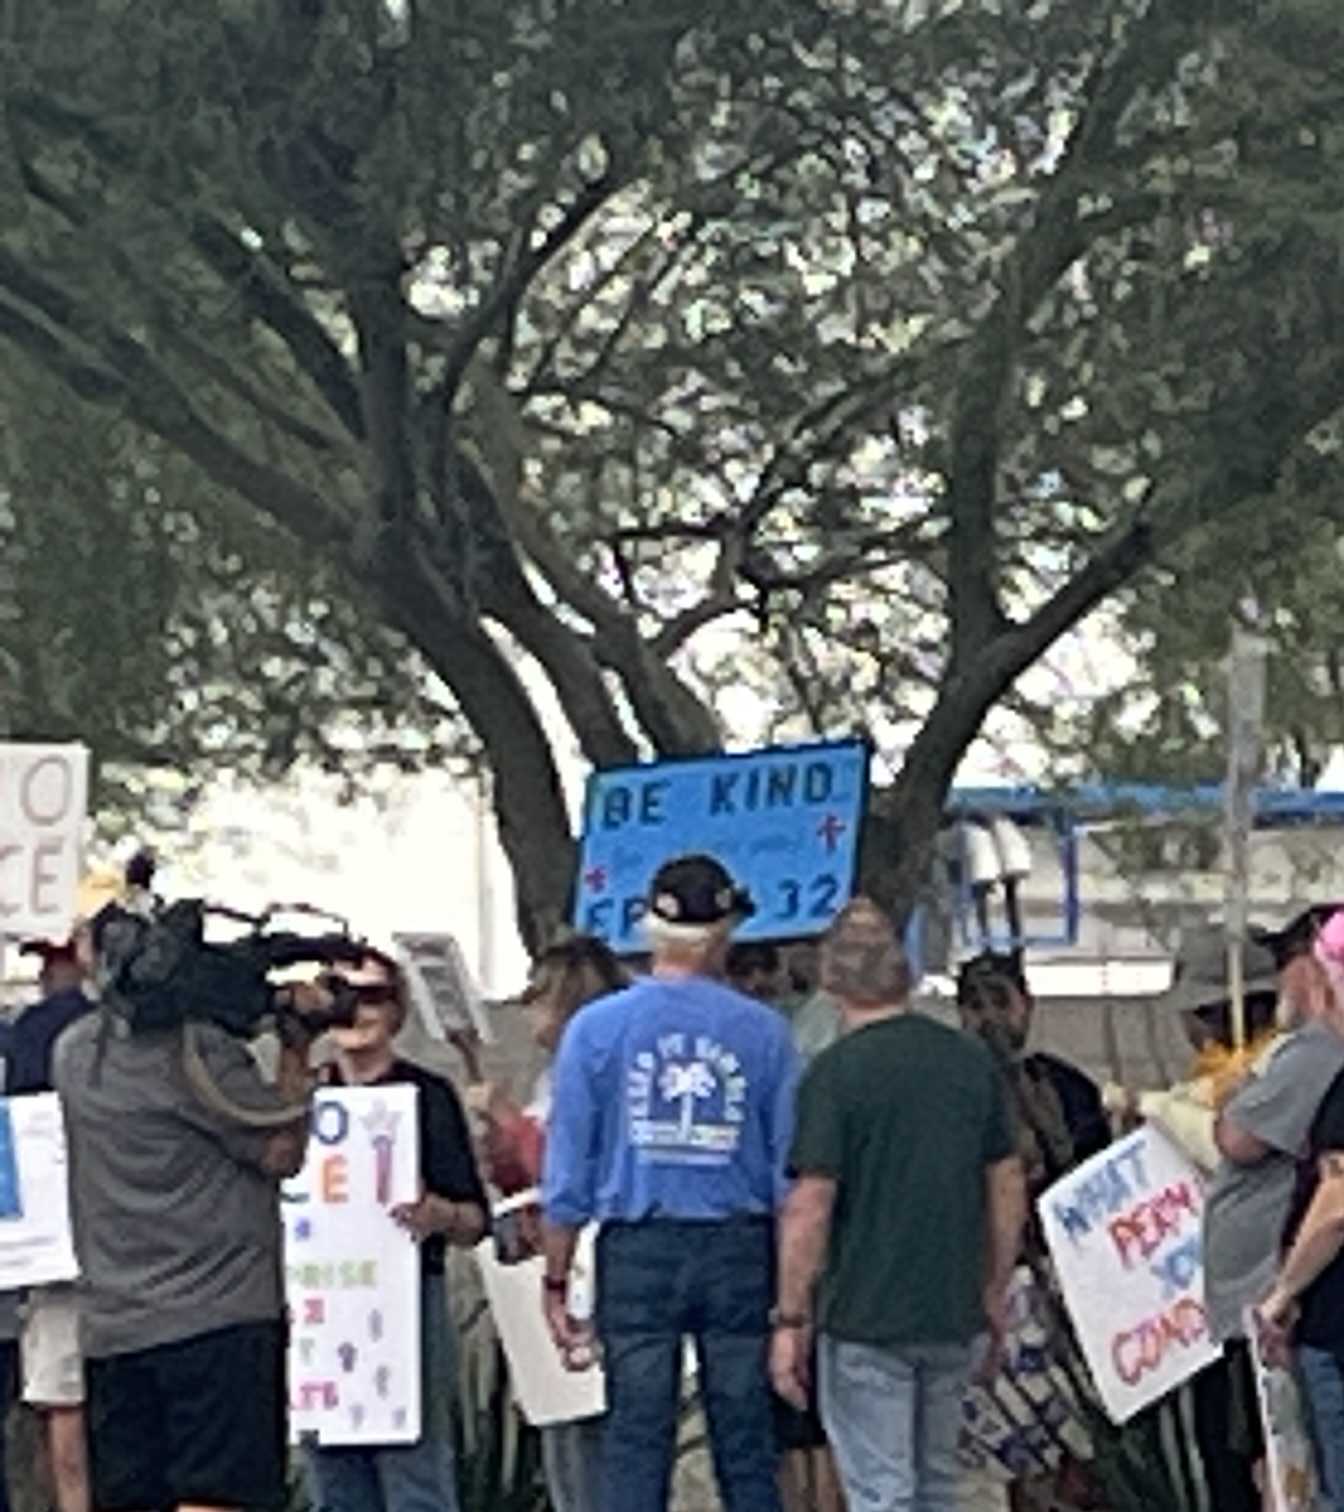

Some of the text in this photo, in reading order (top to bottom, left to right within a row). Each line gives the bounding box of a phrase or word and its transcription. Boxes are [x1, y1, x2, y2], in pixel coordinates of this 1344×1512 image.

[18, 753, 74, 827] O
[601, 762, 834, 831] BE KIND
[0, 836, 66, 915] CE
[586, 873, 841, 942] EP 32
[312, 1101, 349, 1146] O
[1107, 1180, 1200, 1271] PERM
[1110, 1297, 1206, 1387] COND
